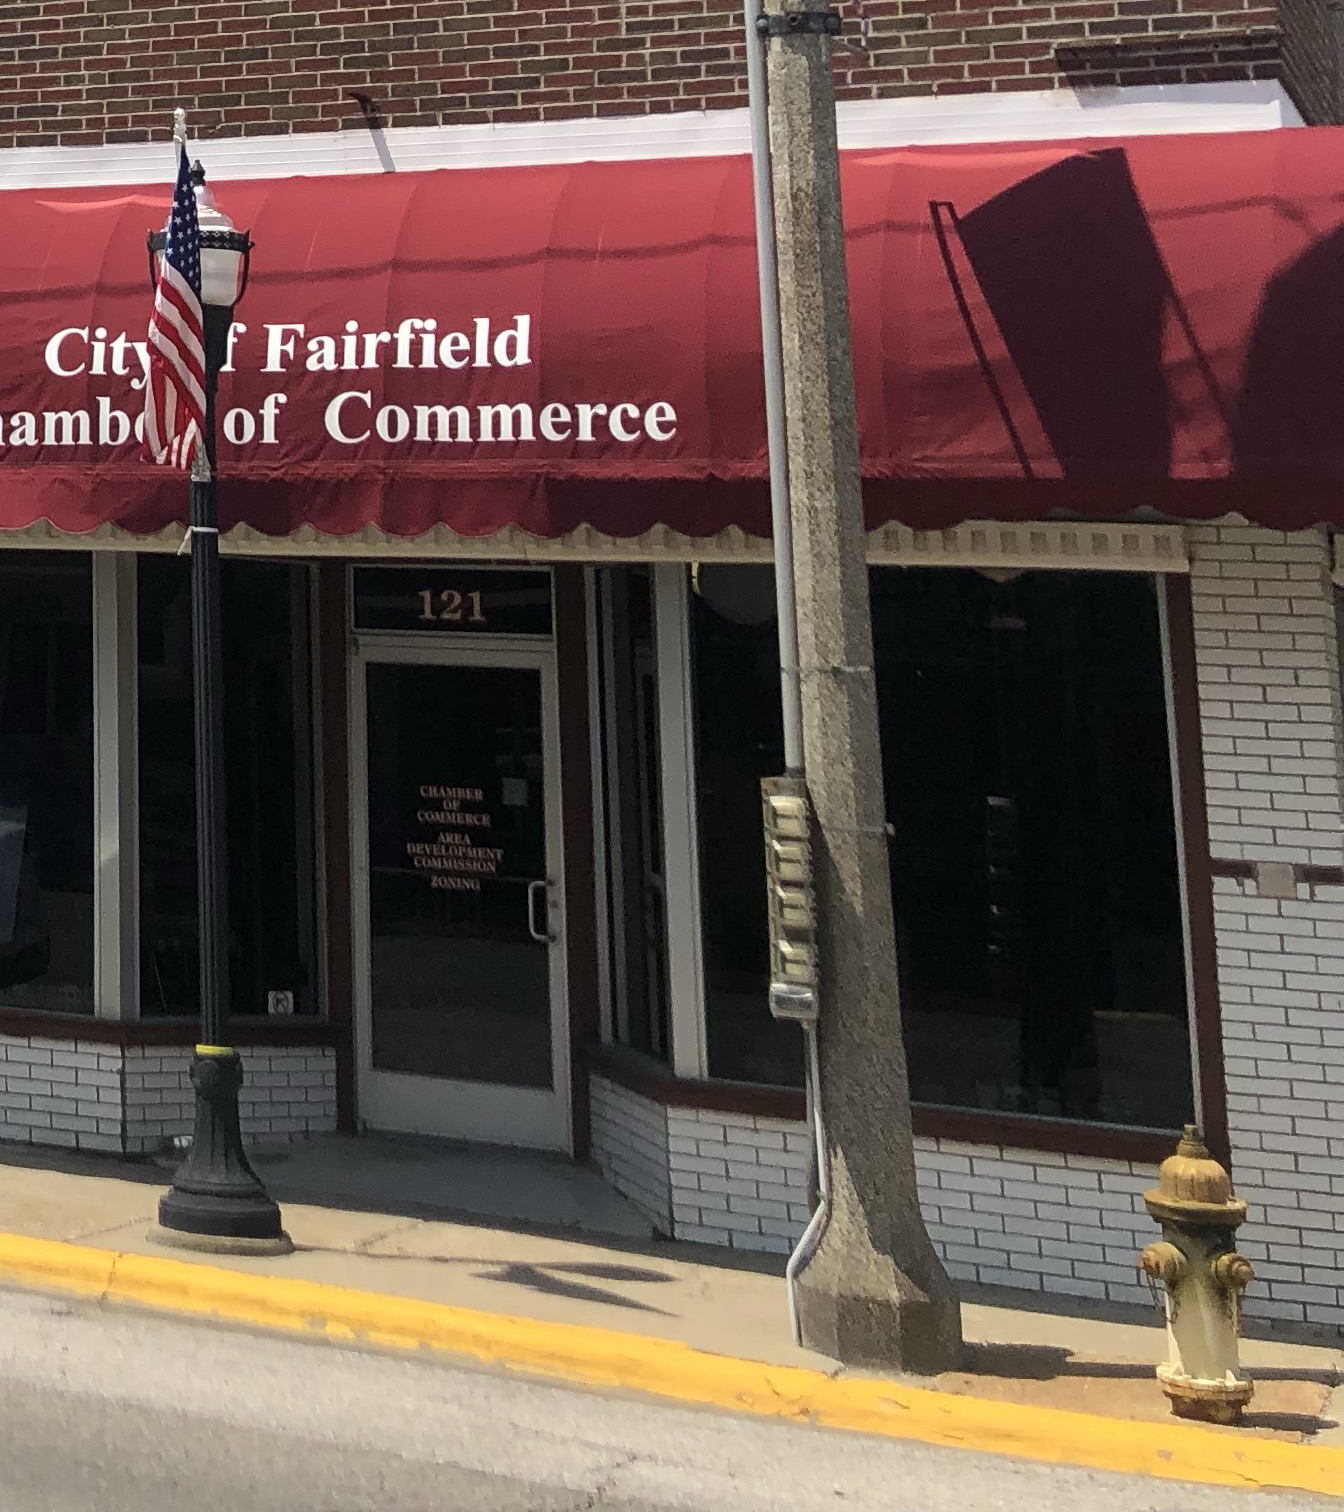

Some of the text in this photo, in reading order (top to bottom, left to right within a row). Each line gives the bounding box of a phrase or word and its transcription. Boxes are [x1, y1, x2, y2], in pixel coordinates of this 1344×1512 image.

[260, 314, 532, 373] Fairfield
[223, 392, 288, 445] of
[324, 390, 678, 444] Commerce
[417, 589, 487, 622] 121
[419, 784, 484, 801] CHAMBER
[442, 799, 461, 811] OF
[416, 809, 492, 827] COMMERCE
[437, 831, 471, 846] AREA
[406, 842, 504, 862] DEVELOPMENT
[413, 855, 496, 874] COMMISSION
[430, 874, 481, 891] ZONING
